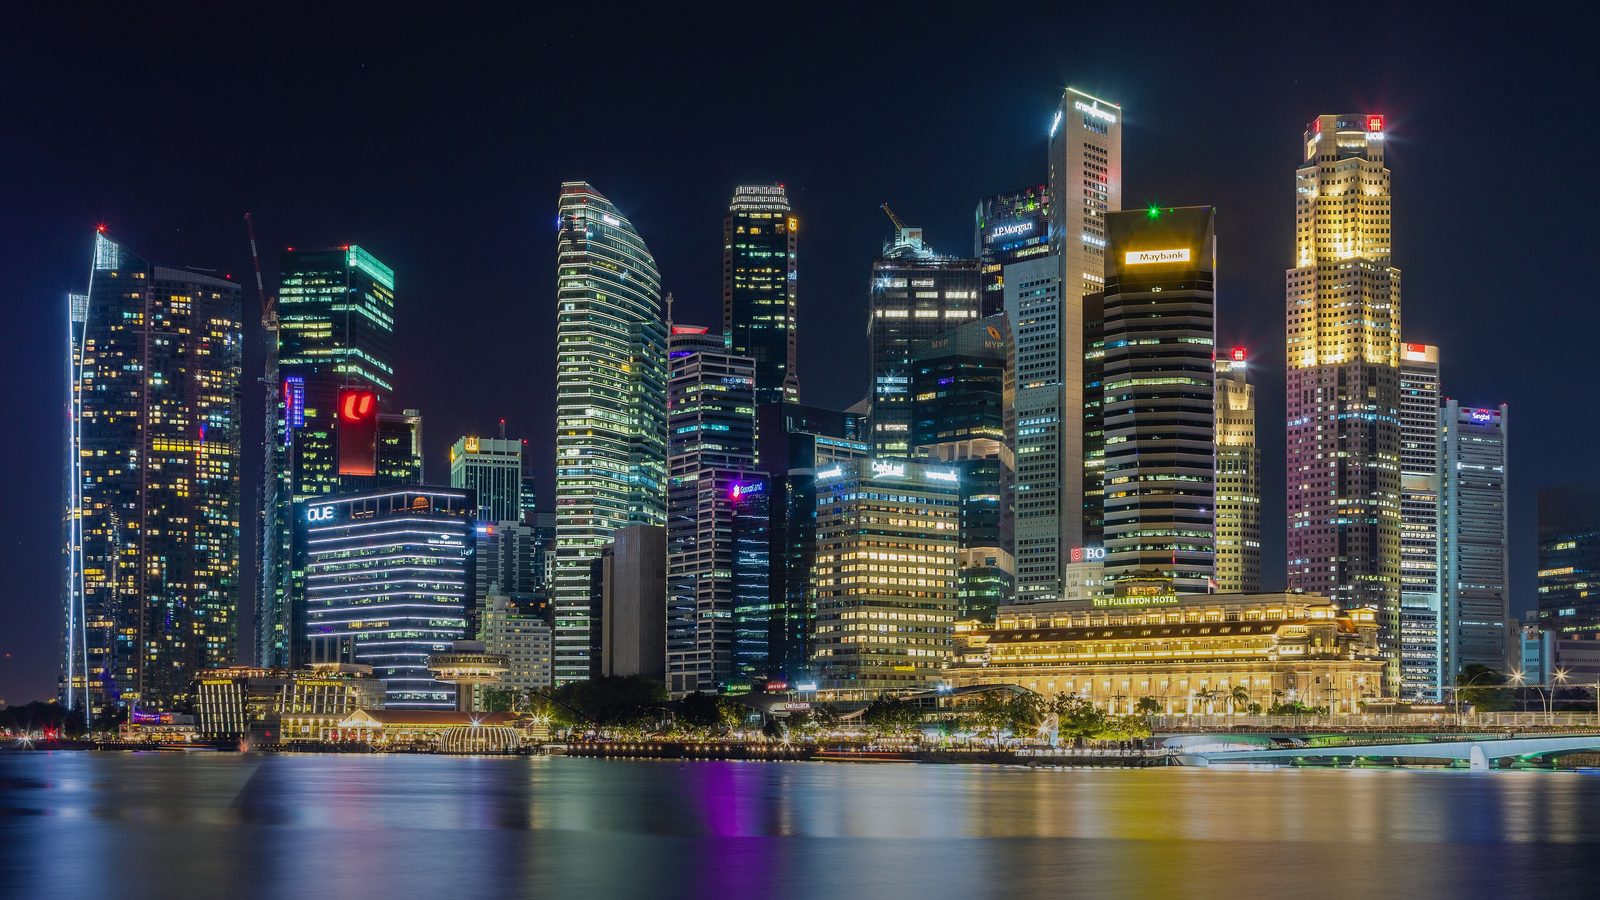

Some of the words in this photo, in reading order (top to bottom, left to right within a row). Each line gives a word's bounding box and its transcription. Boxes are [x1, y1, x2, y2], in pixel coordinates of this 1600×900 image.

[993, 222, 1032, 236] J.P.Morgan
[1140, 251, 1184, 262] Maybank
[931, 339, 949, 350] MYP
[984, 340, 1004, 350] MYP
[307, 506, 334, 521] OUE
[1109, 597, 1150, 606] FULLERTON
[1152, 595, 1178, 604] HOTEL
